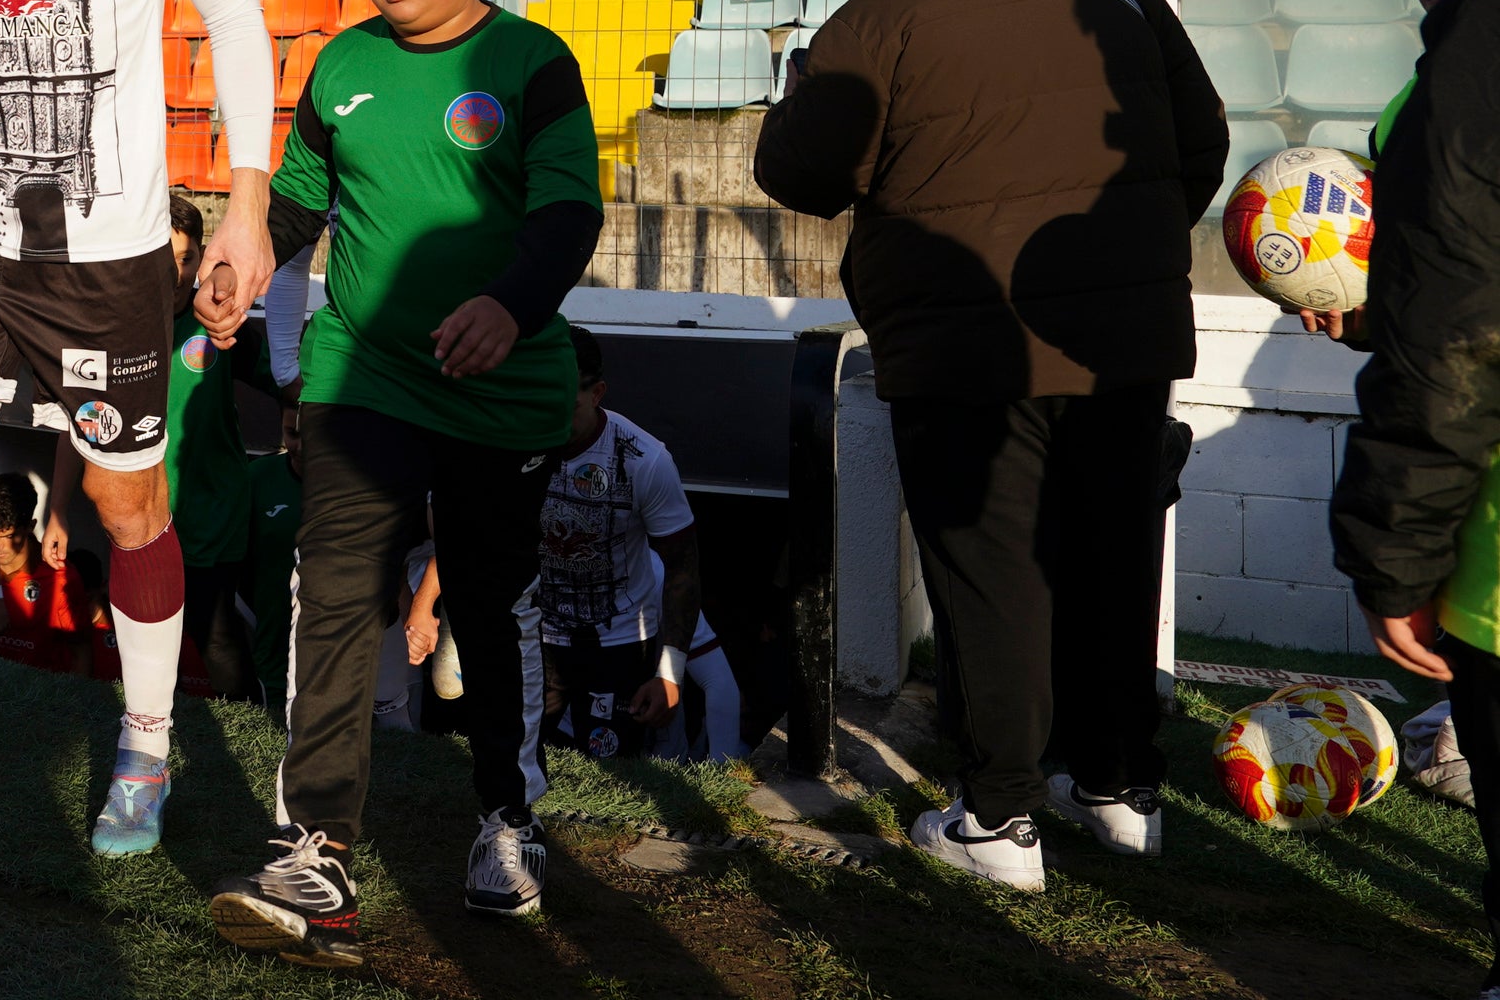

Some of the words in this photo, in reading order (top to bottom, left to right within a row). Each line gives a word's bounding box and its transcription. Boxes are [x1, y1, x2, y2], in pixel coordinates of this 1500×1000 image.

[1330, 170, 1363, 196] VICTORIA
[113, 357, 121, 365] El
[149, 350, 158, 358] de
[112, 359, 158, 376] Gonzalo
[112, 371, 157, 384] SALAMANCA
[135, 429, 159, 442] umbro
